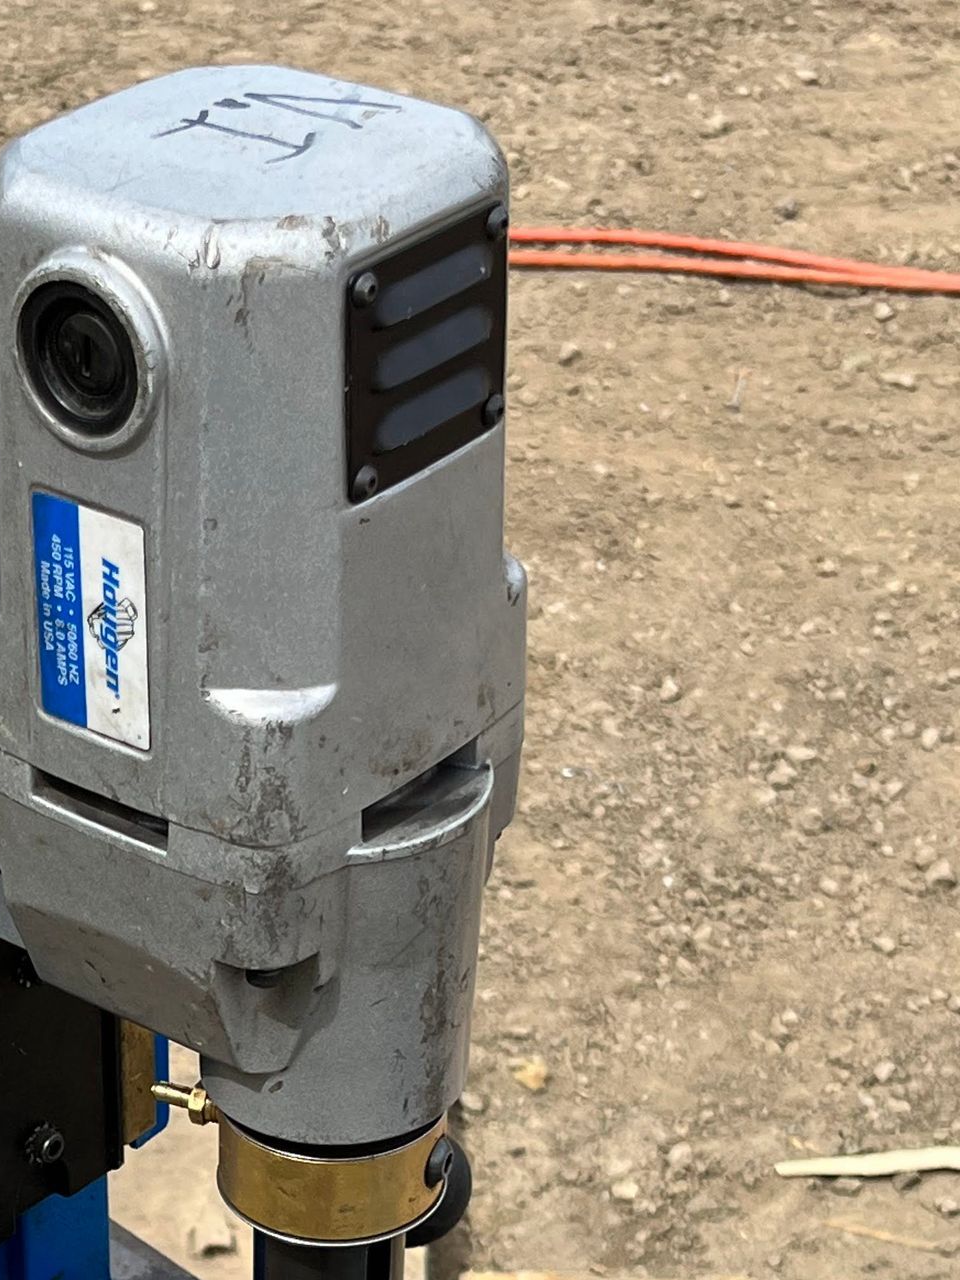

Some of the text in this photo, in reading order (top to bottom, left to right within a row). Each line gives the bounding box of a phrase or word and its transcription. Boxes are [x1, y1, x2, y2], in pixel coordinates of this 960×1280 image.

[50, 533, 62, 562] 450
[52, 562, 63, 599] RPM
[40, 560, 55, 651] Made in USA
[63, 546, 80, 685] 115 VAC 50/60 HZ
[56, 641, 68, 686] AMPS
